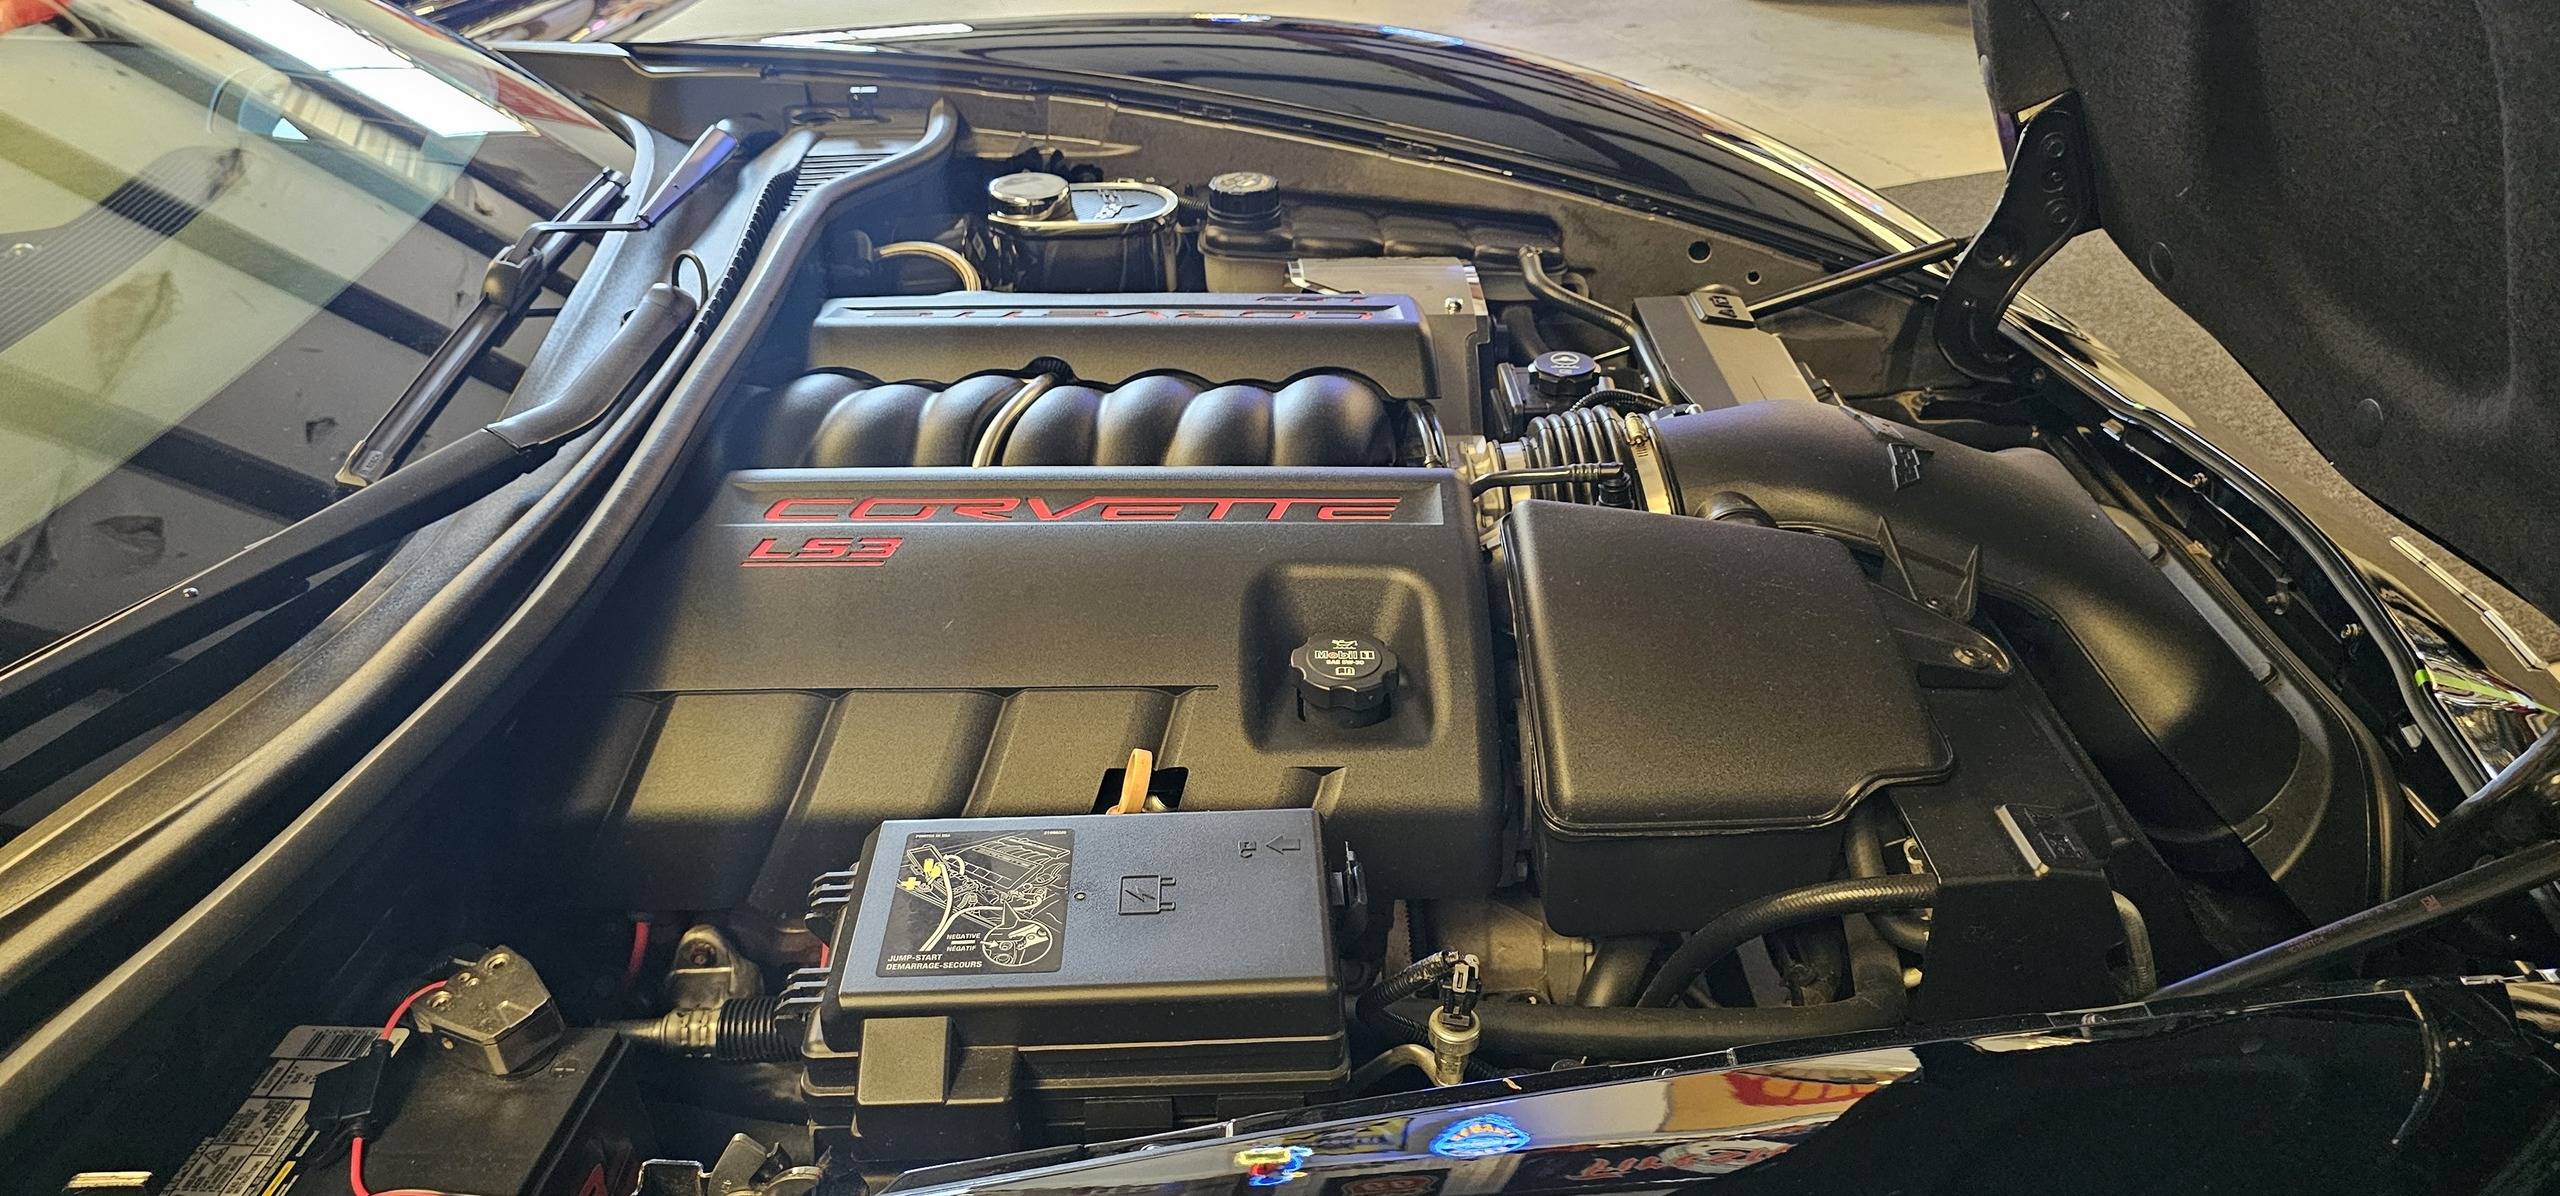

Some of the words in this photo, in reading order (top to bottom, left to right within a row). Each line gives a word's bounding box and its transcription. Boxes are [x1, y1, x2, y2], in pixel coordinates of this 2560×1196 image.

[763, 497, 1402, 521] CORVETTE
[748, 537, 904, 562] LS3
[1314, 650, 1358, 660] Mobil
[887, 954, 942, 962] JUMP-START
[886, 961, 983, 970] DEMARRAGE-SECOURS
